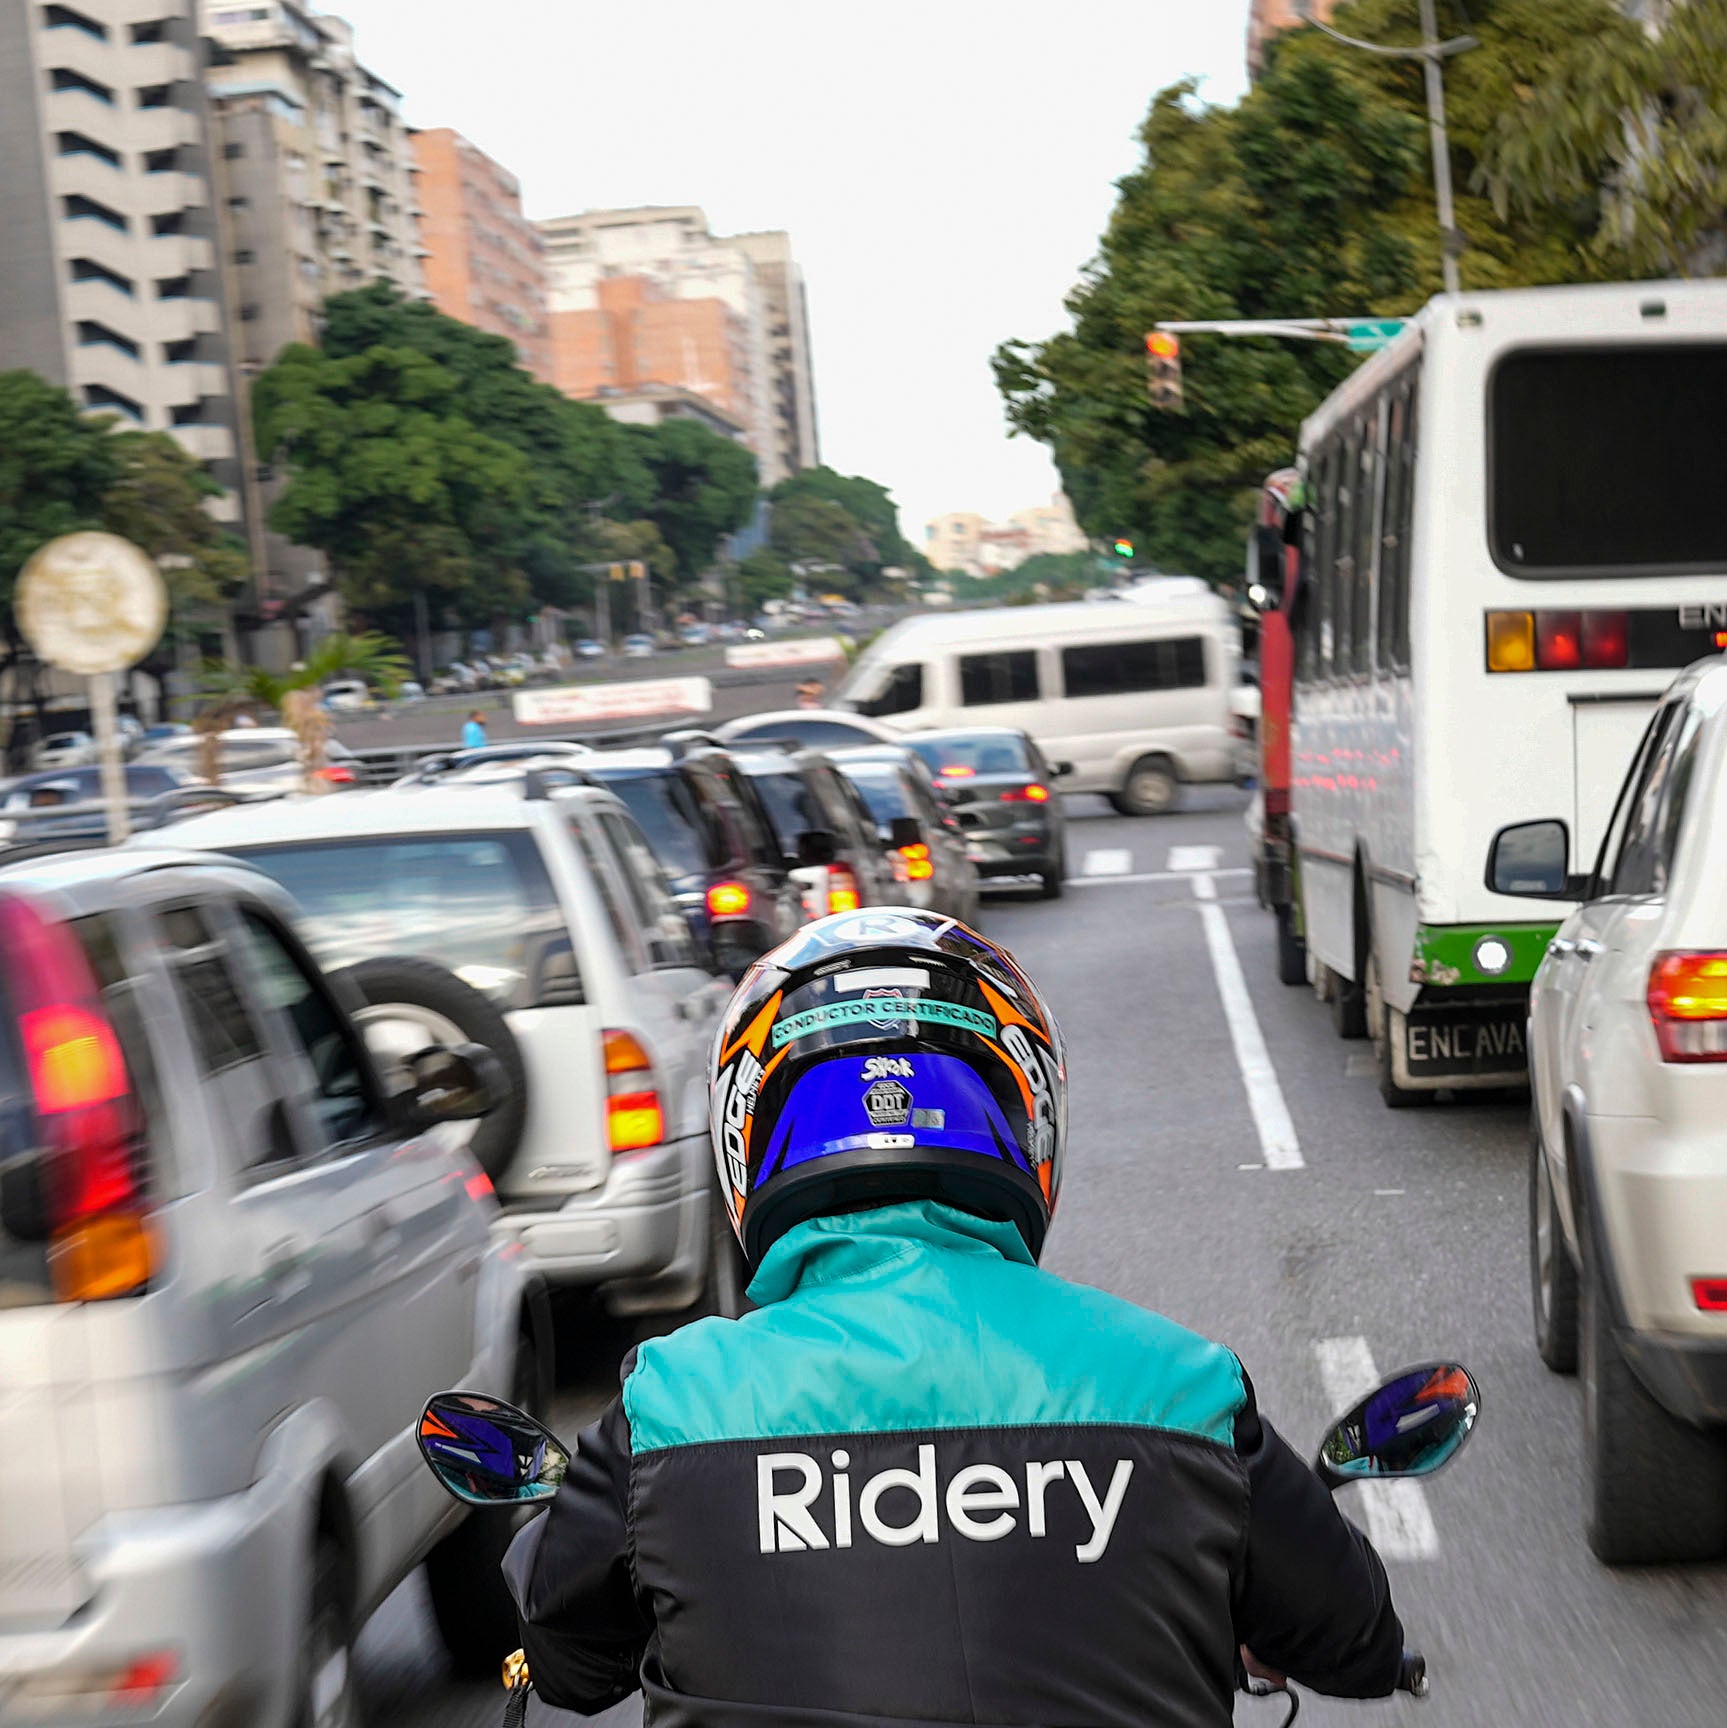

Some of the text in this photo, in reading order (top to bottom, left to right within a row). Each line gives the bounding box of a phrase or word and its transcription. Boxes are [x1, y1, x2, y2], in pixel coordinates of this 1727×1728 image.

[774, 1001, 996, 1039] CONDUCTOR CERTIFICADO
[1409, 1023, 1523, 1060] ENCAVA
[723, 1050, 762, 1198] EDGE
[1000, 1024, 1055, 1166] EDGE
[756, 1444, 1135, 1563] Ridery
